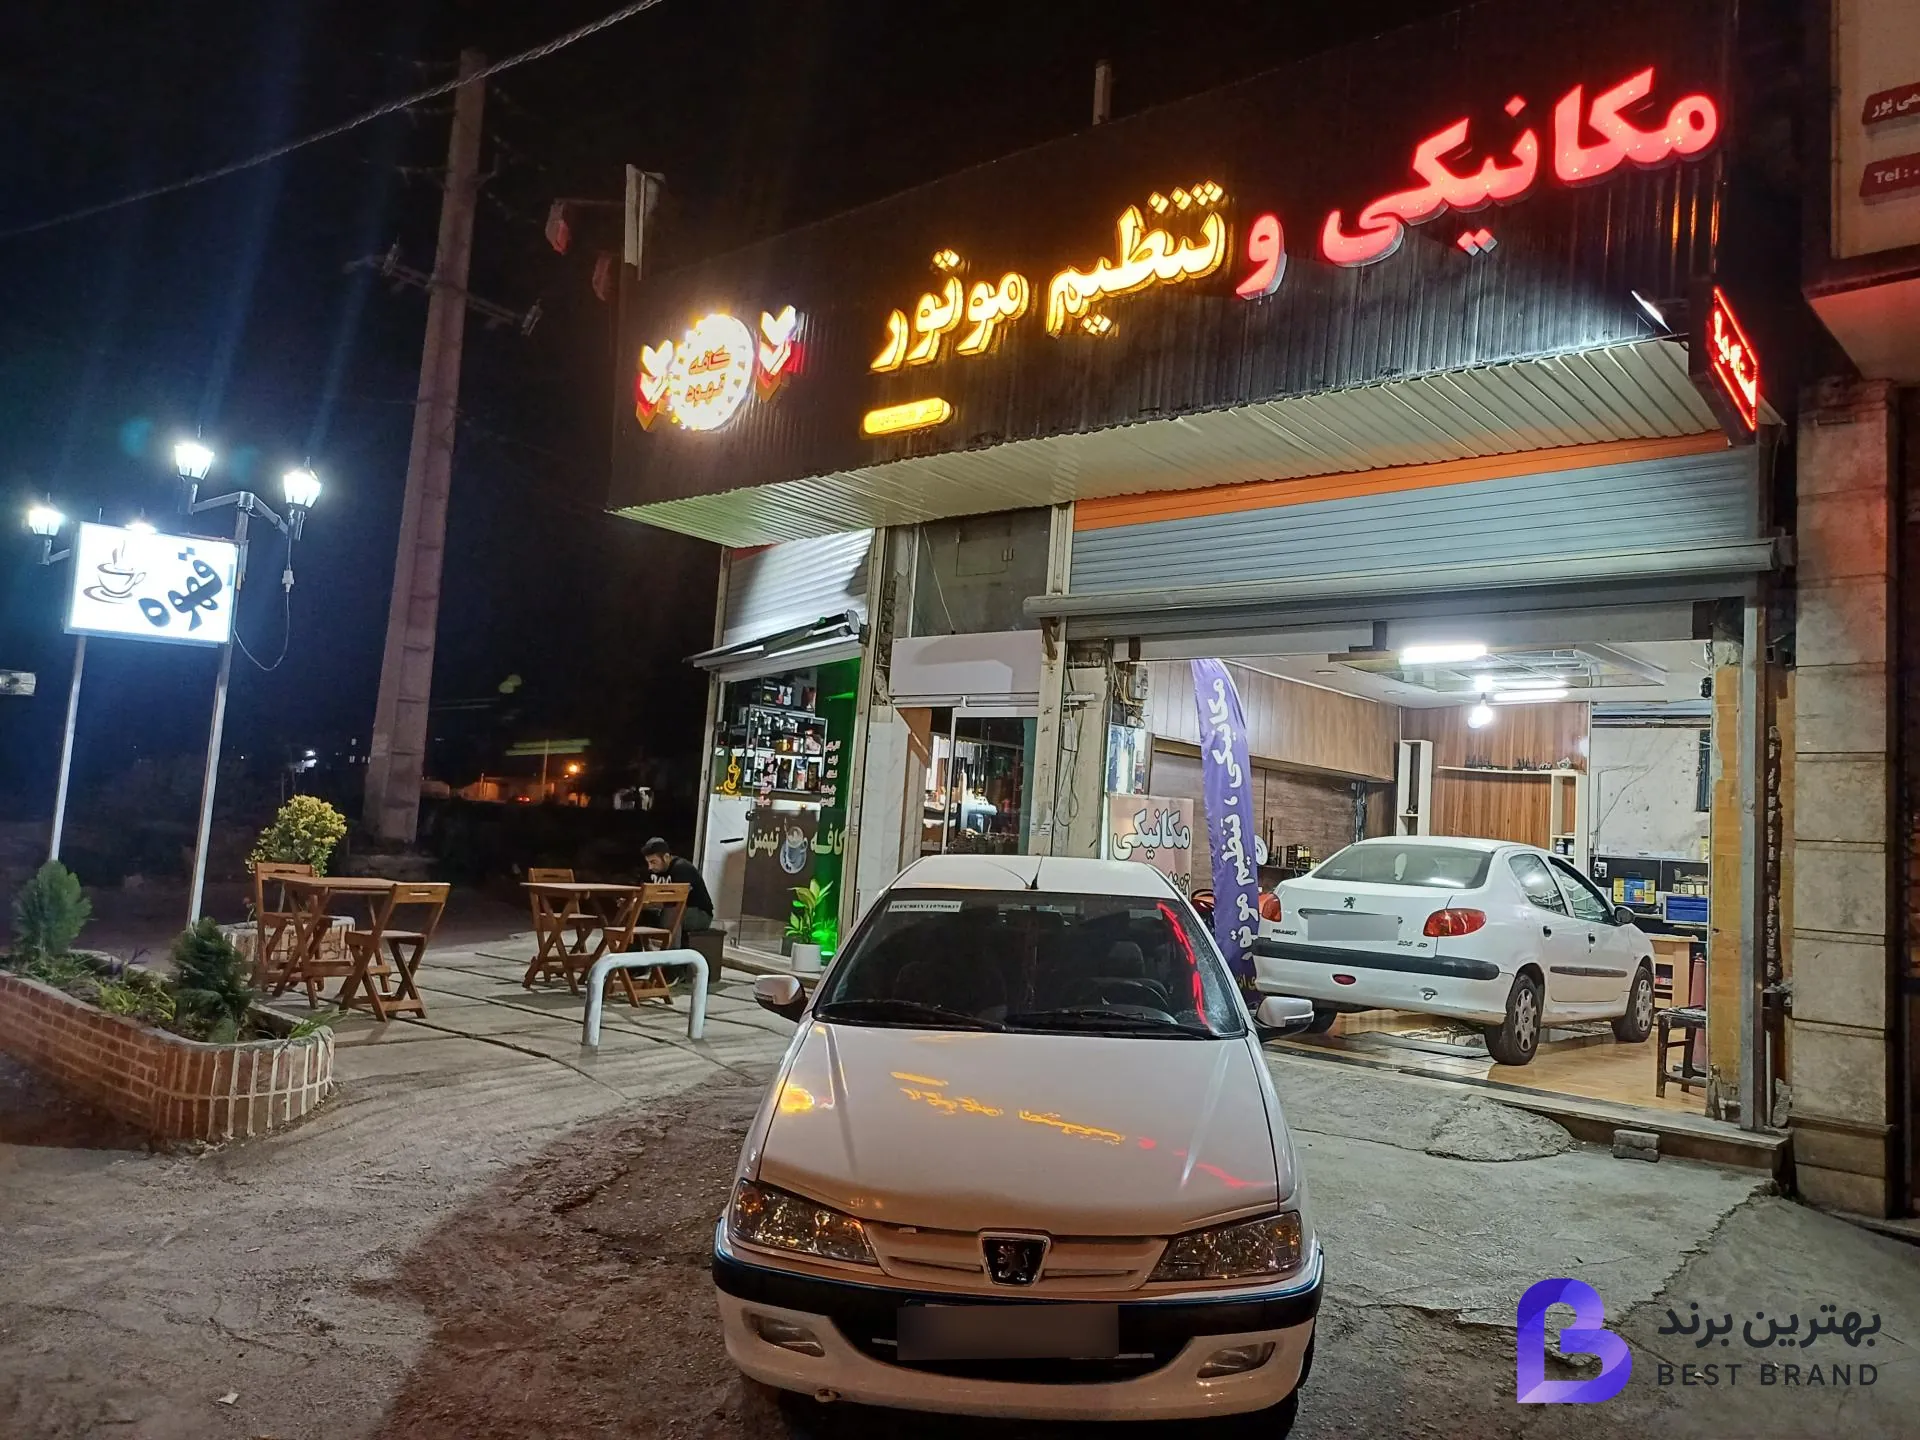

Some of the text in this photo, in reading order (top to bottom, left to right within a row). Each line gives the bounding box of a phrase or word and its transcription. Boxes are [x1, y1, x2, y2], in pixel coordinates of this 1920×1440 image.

[1872, 98, 1893, 118] پور
[869, 66, 1718, 373] مکانیکی و تنظیم موتور
[688, 345, 731, 375] کافه
[138, 547, 223, 631] قهوه
[1208, 680, 1242, 787] مکانیکی
[1112, 808, 1190, 860] مکانیکی
[1221, 814, 1255, 887] تنظیم
